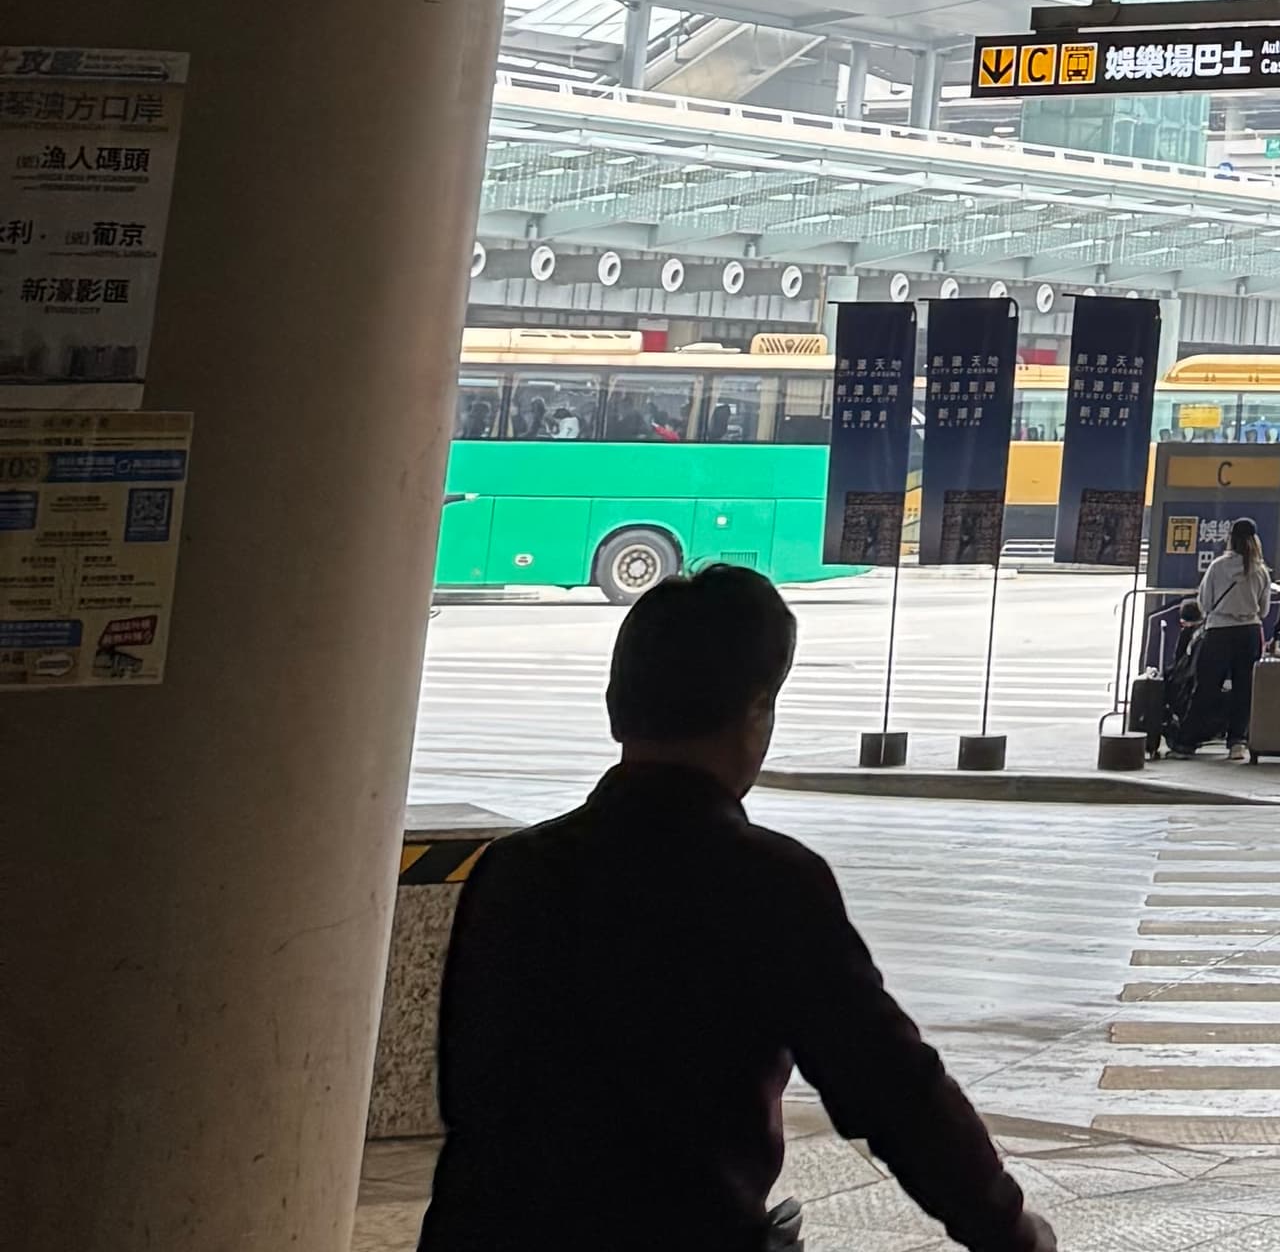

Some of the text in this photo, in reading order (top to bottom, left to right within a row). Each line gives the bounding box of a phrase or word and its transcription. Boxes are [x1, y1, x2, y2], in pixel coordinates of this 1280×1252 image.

[1027, 48, 1048, 82] C
[1105, 41, 1253, 80] 娛樂場巴士
[0, 92, 163, 123] 琴澳方口岸
[1217, 461, 1232, 486] C
